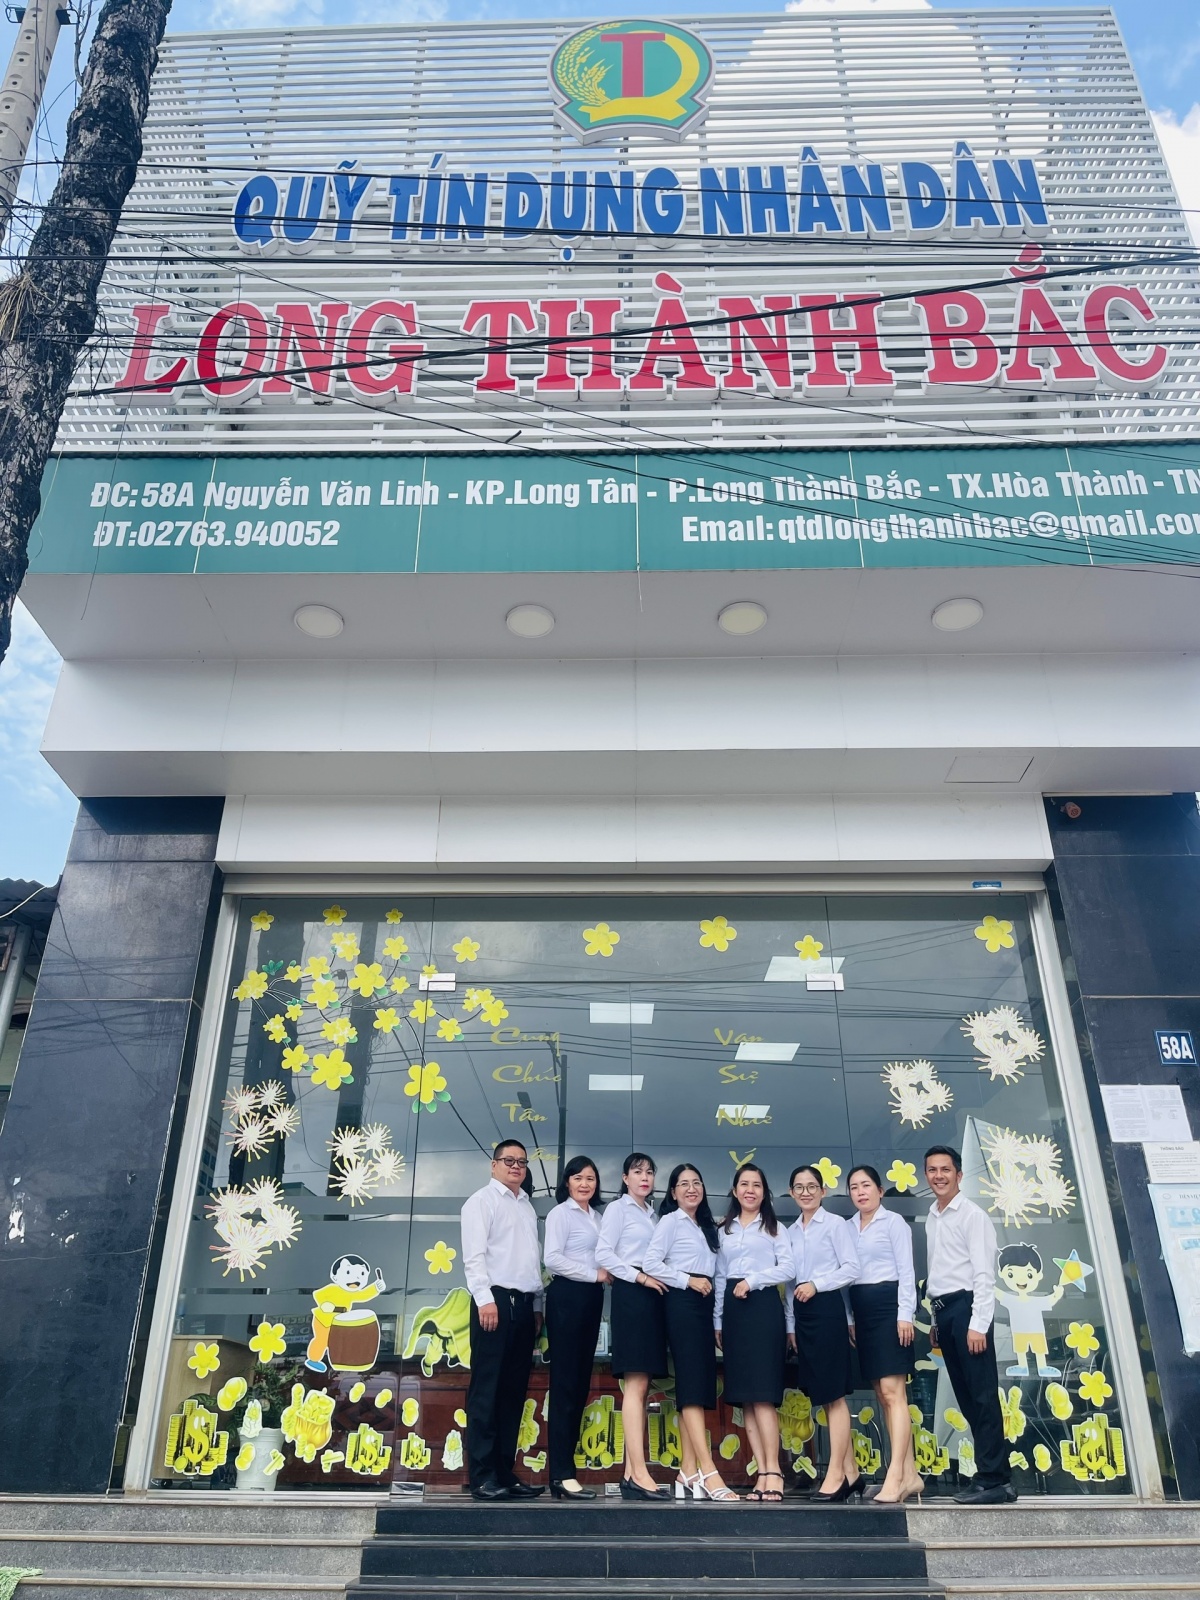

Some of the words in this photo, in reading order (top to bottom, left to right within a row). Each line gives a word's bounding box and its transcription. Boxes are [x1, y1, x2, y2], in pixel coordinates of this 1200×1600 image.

[233, 159, 375, 248] QUỸ
[388, 152, 490, 241] TÍN
[502, 166, 686, 262] DỤNG
[699, 146, 893, 236] NHÂN
[901, 140, 1040, 232] DÂN
[113, 300, 426, 396] LONG
[461, 271, 898, 394] THÀNH
[913, 243, 1167, 384] BẮC
[203, 476, 310, 510] Nguyễn
[320, 480, 371, 506] Văn
[380, 480, 439, 506] Linh
[465, 480, 580, 507] KP.Long
[587, 477, 637, 504] Tân
[668, 477, 764, 505] P.Long
[771, 474, 858, 501] Thành
[865, 470, 922, 500] Bắc
[946, 471, 1050, 499] TX.Hòa
[1055, 469, 1149, 497] Thành
[92, 520, 341, 547] ĐT:02763.940052
[490, 1027, 561, 1057] Cung
[1160, 1036, 1193, 1060] 58A
[492, 1061, 562, 1083] Chúc
[501, 1103, 548, 1123] Tân
